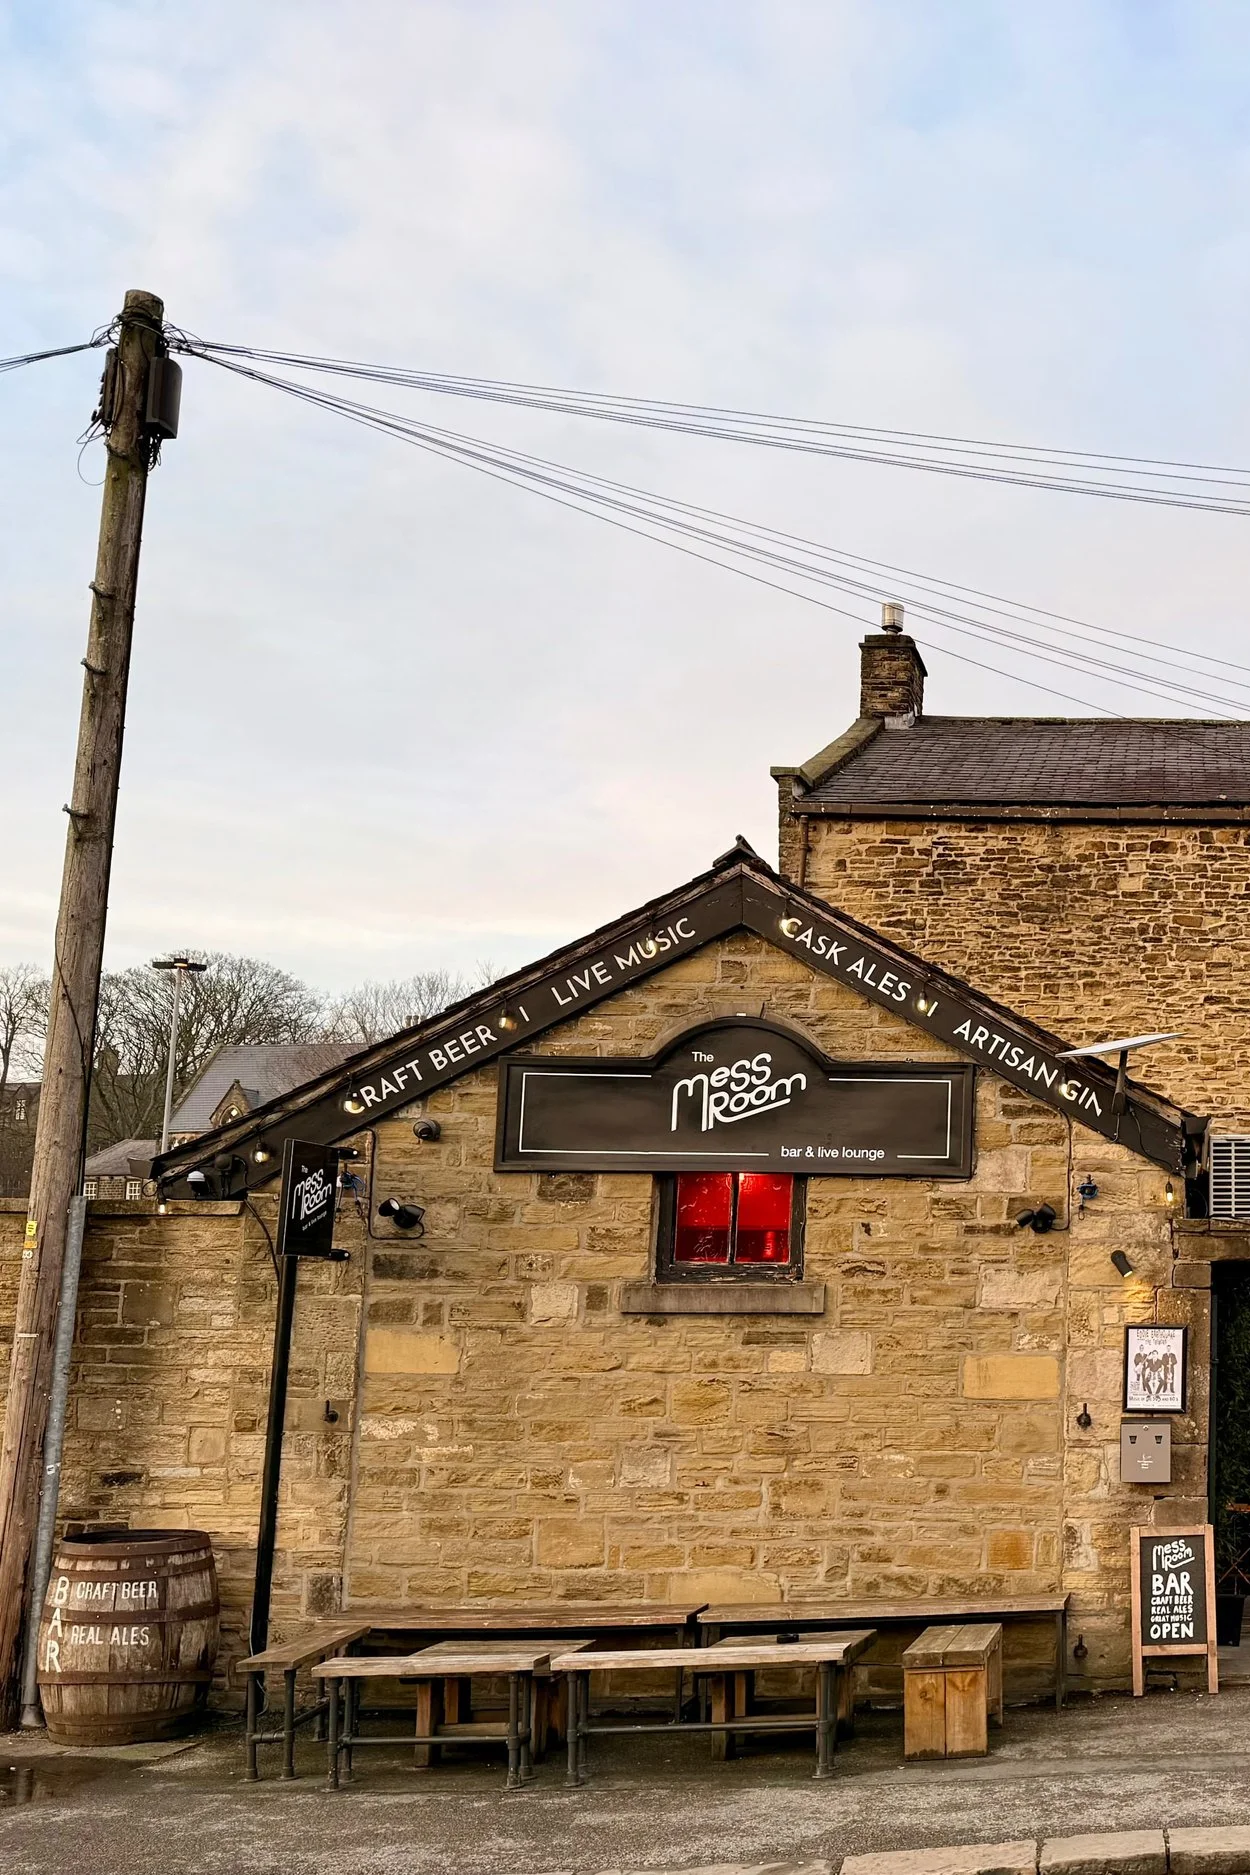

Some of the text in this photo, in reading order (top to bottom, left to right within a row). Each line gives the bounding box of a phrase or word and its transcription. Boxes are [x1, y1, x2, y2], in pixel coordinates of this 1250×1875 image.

[781, 917, 848, 966] CASK
[846, 956, 912, 1002] ALES
[953, 1019, 1059, 1089] ARTISAN
[344, 1060, 423, 1114] CRAFT
[428, 1024, 498, 1071] BEER
[550, 961, 612, 1006] LIVE
[614, 917, 696, 970] MUSIC
[692, 1051, 714, 1063] The
[781, 1146, 885, 1161] bar & live lounge
[76, 1581, 157, 1600] CRAFT BEER
[1152, 1571, 1194, 1595] BAR
[1151, 1595, 1193, 1606] CRAFT BEER
[1150, 1614, 1192, 1623] GREAT MUSIC
[1151, 1605, 1193, 1615] REAL ALES
[44, 1576, 70, 1673] BAR
[1150, 1622, 1194, 1639] OPEN
[71, 1625, 150, 1647] REAL ALES
